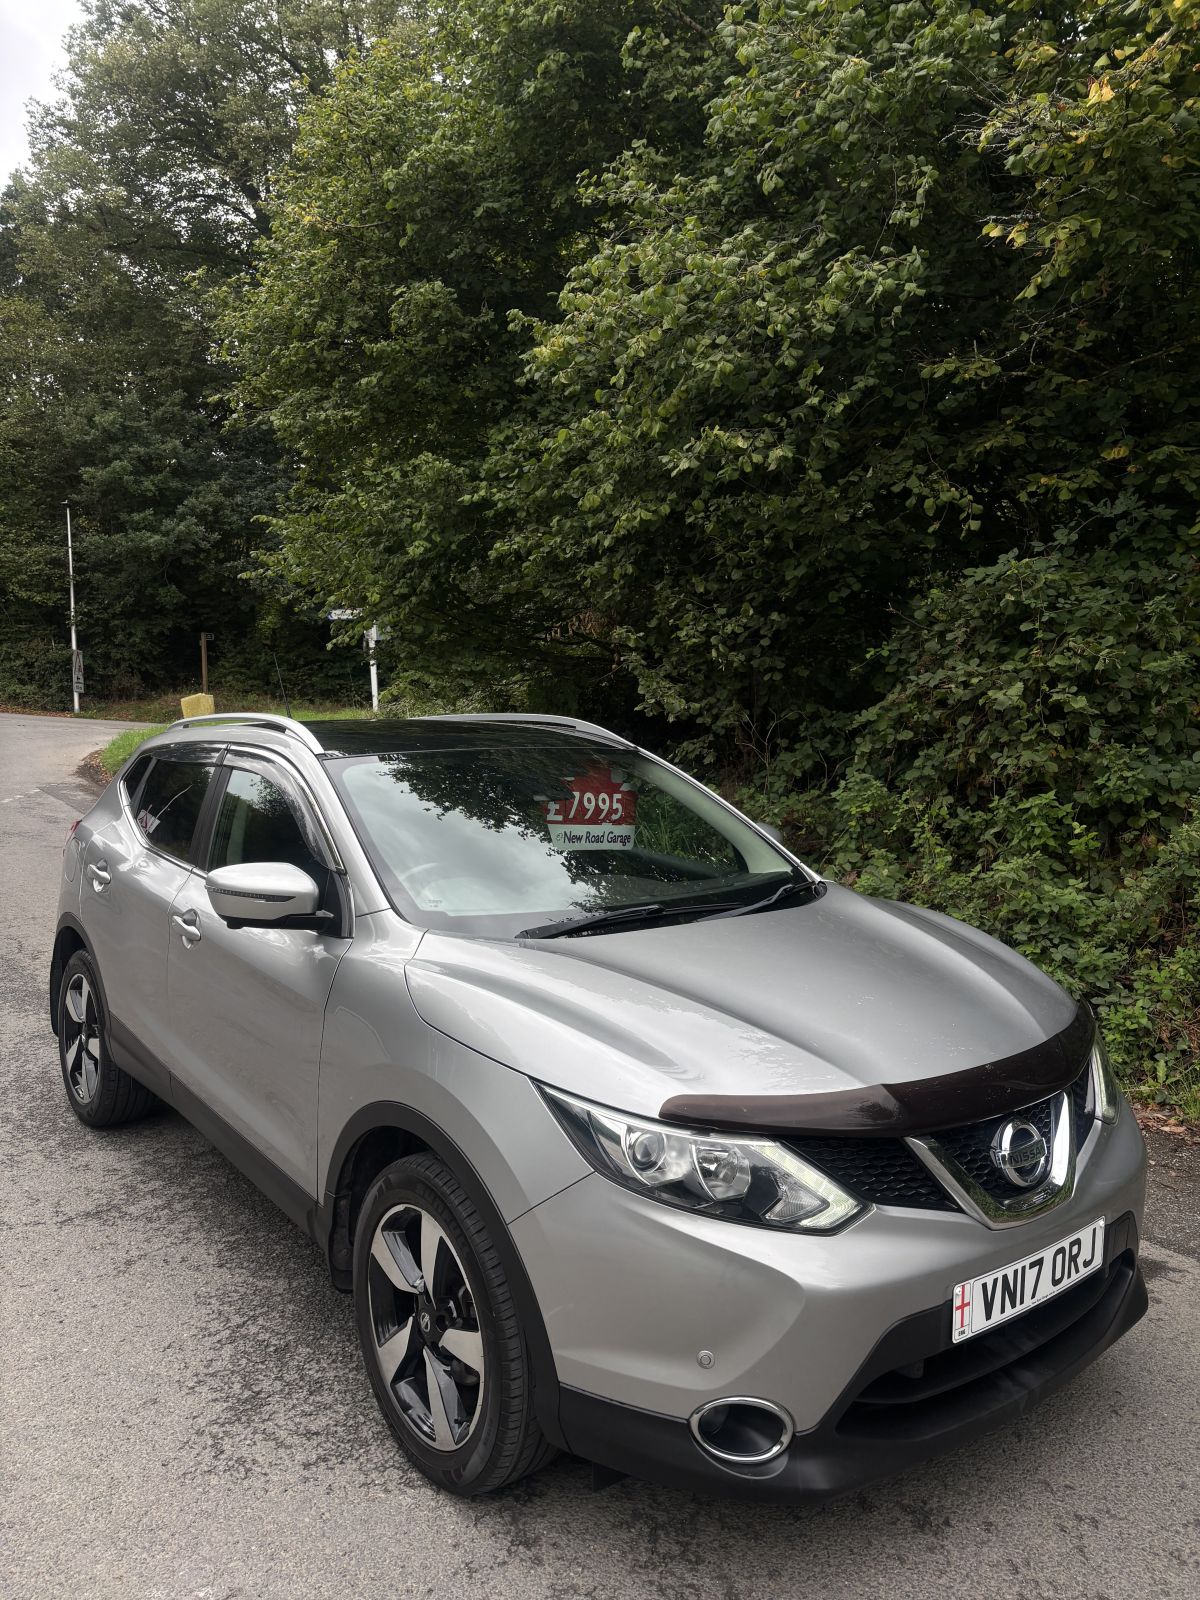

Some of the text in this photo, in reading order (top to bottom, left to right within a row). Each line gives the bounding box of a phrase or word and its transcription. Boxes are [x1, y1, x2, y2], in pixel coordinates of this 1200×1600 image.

[563, 831, 631, 847] New Road Garage
[981, 1227, 1097, 1322] VN17 ORJ
